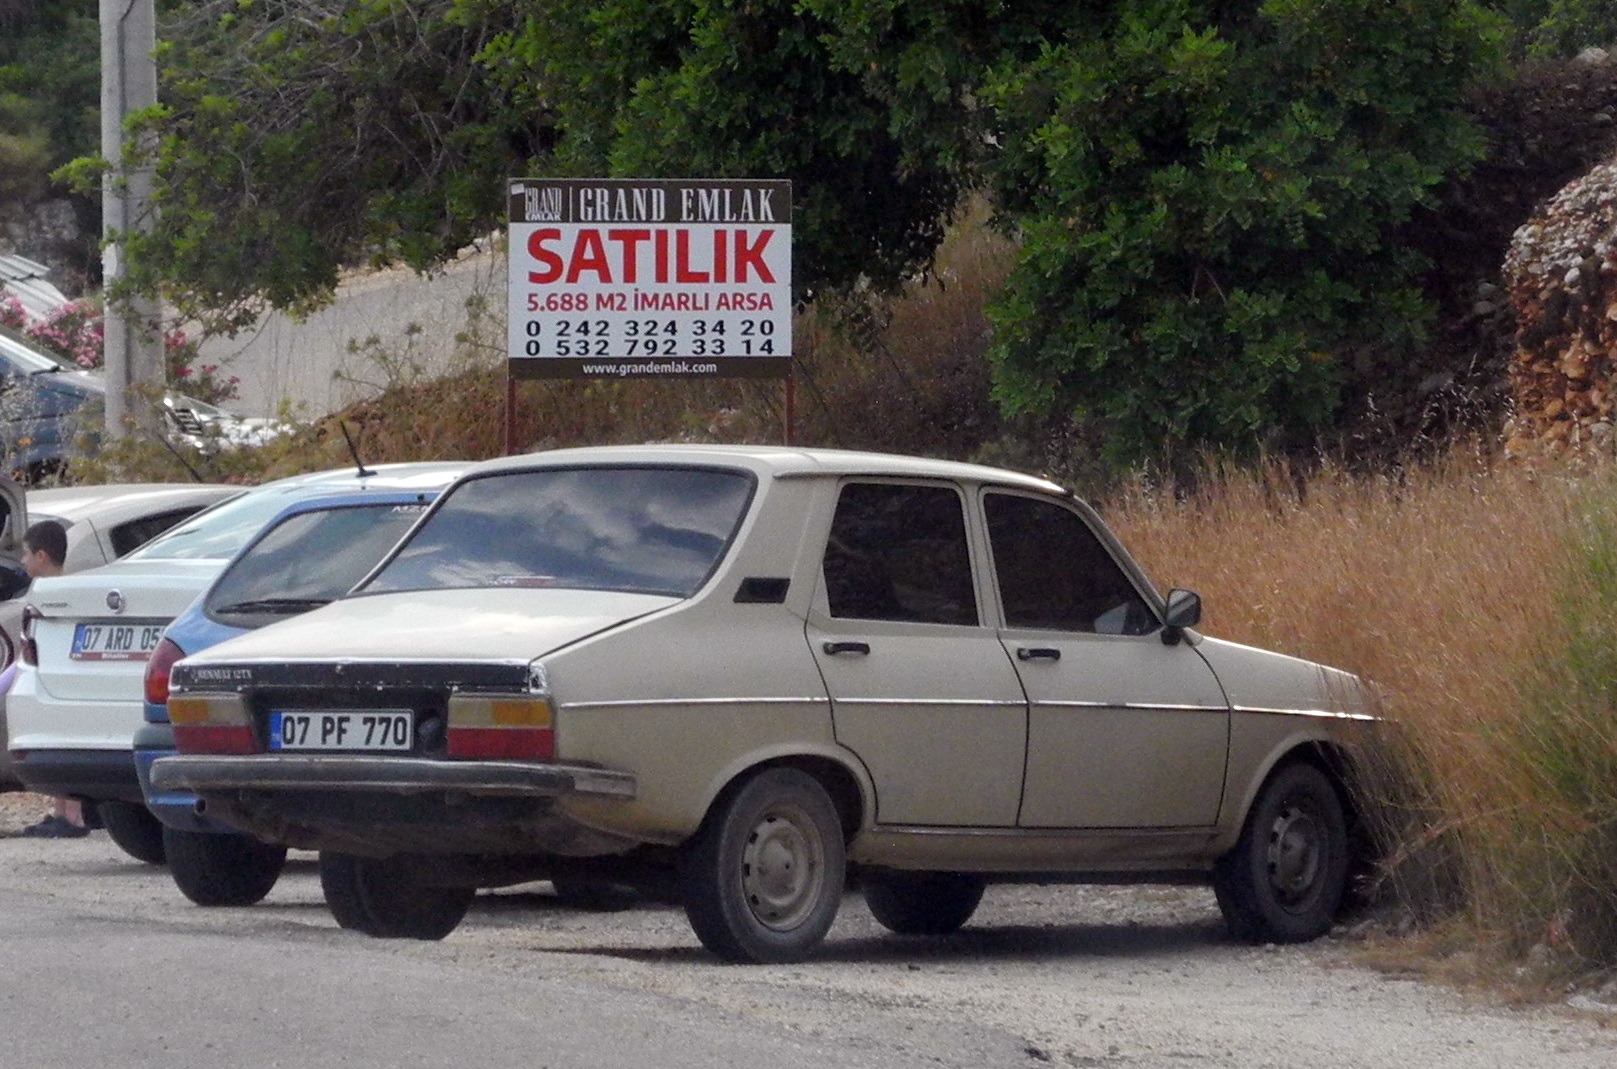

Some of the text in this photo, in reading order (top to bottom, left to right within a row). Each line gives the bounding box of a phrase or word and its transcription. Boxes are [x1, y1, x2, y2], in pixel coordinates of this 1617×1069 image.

[525, 187, 562, 211] GRAND
[580, 188, 775, 221] GRAND EMLAK
[525, 211, 562, 221] EMLAK
[527, 228, 777, 284] SATILIK
[527, 288, 774, 311] 5.688 M2 İMARLI ARSA
[525, 320, 774, 337] 0 242 324 34 20
[525, 339, 774, 356] 0 532 792 33 14
[582, 361, 717, 376] www.grandemlak.com
[82, 627, 165, 650] 07 ARD 05
[282, 716, 407, 745] 07 PF 770
